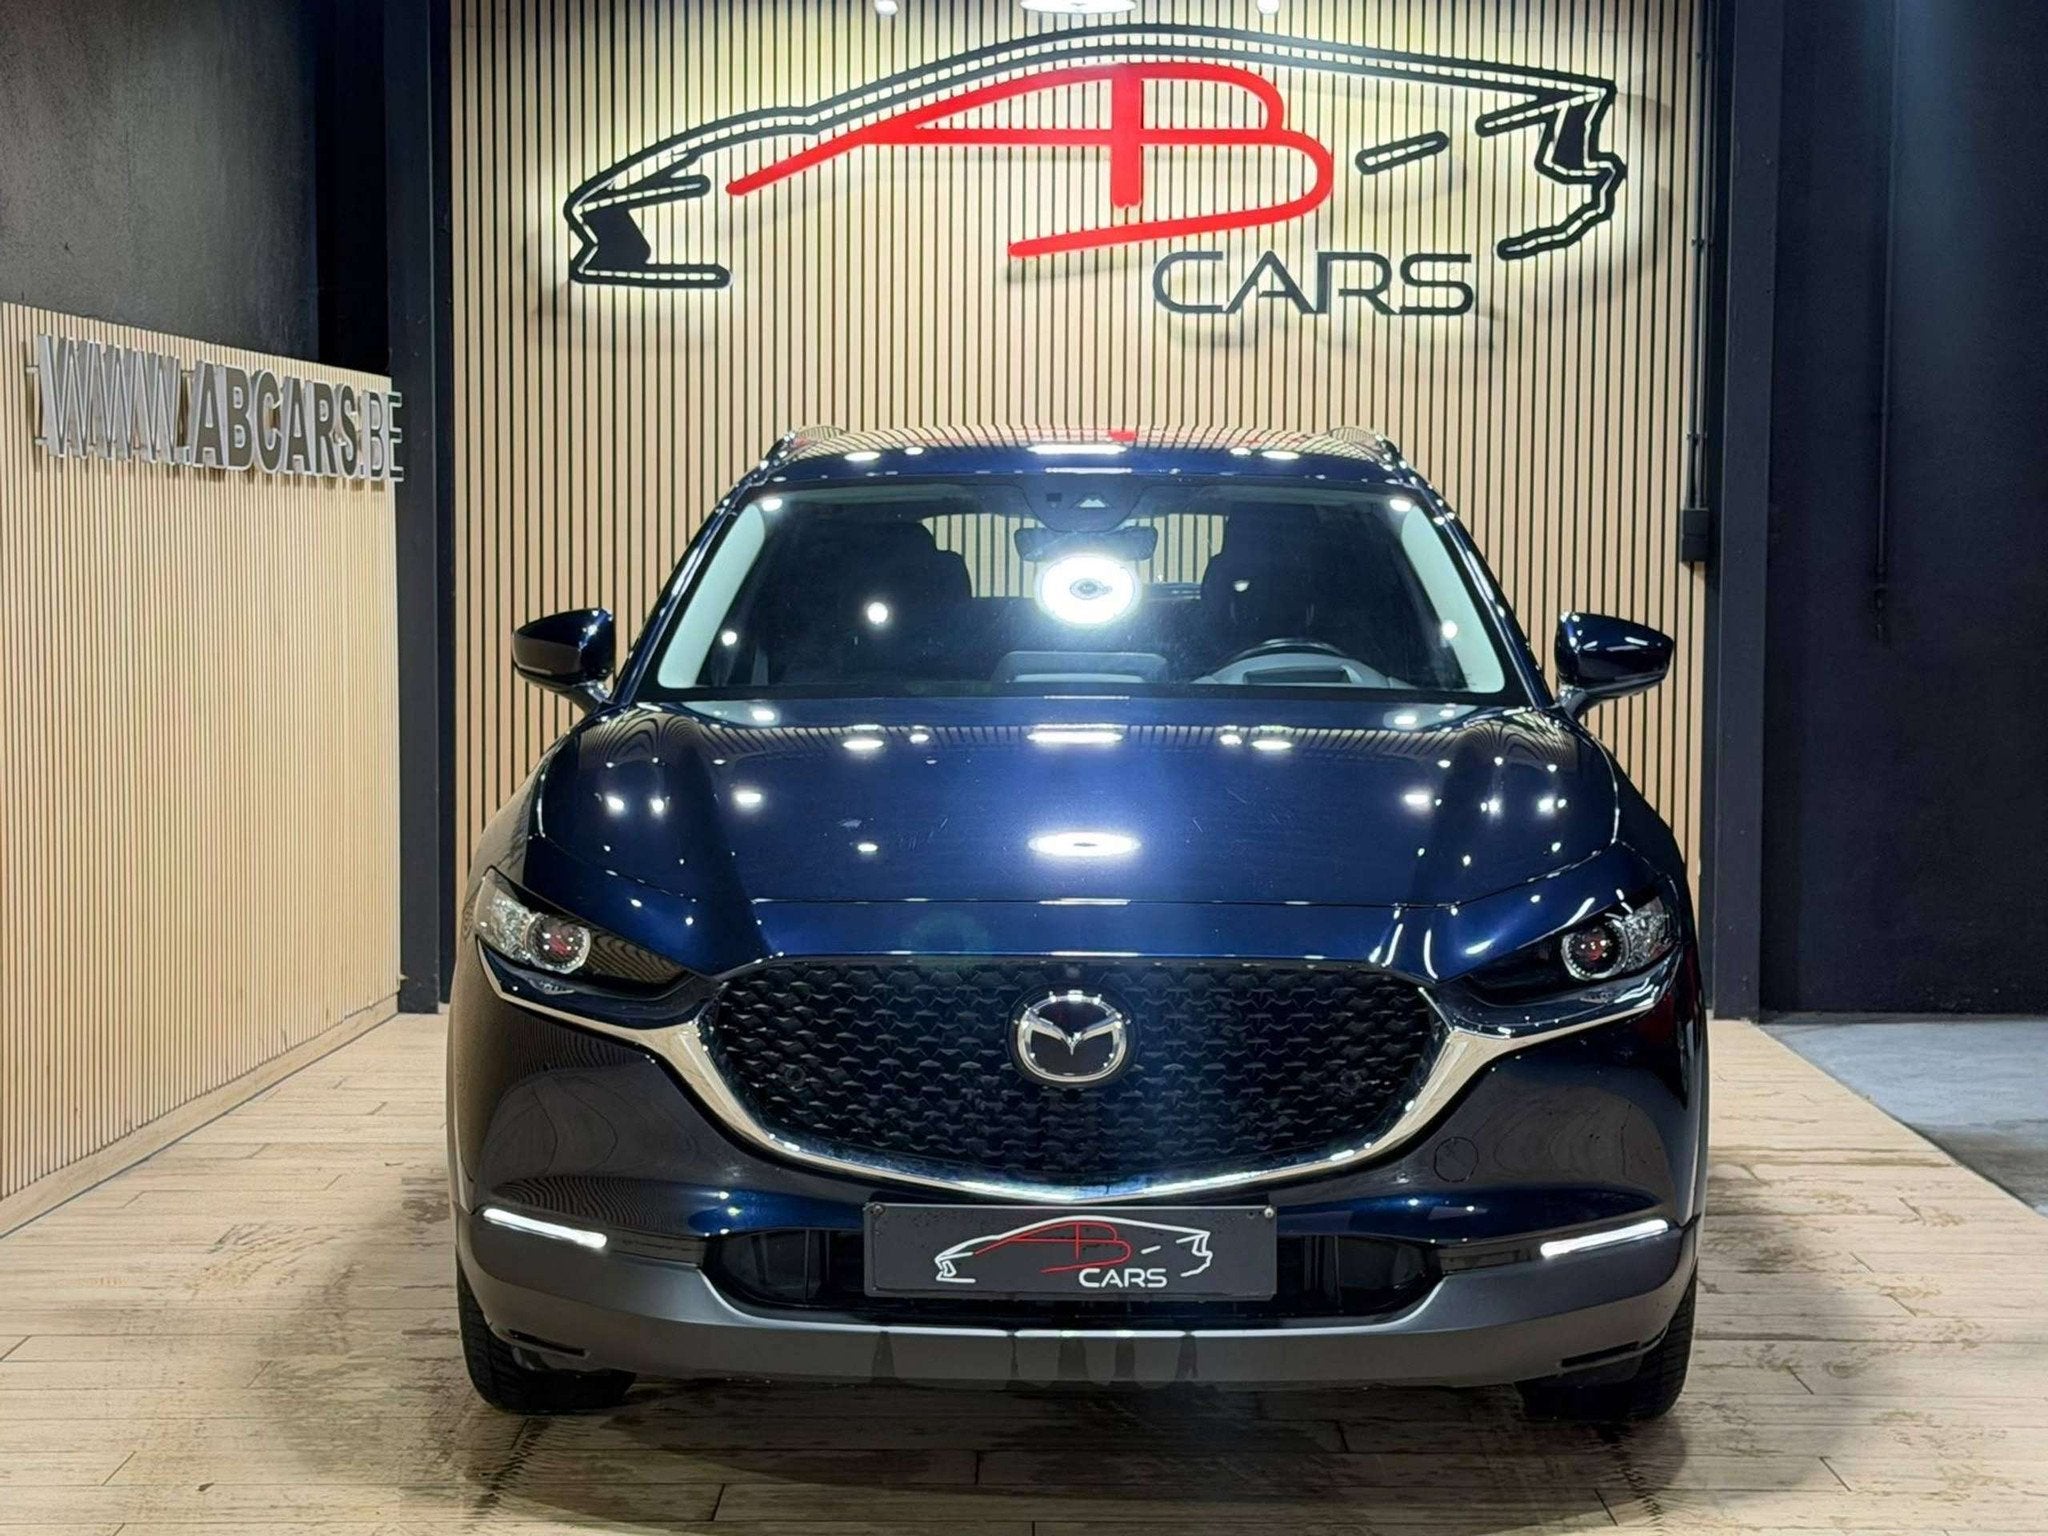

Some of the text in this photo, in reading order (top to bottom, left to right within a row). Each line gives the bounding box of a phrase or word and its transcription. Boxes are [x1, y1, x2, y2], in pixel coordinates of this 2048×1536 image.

[1153, 250, 1474, 315] CARS
[38, 334, 404, 482] WWW.ABCARS.BE
[1079, 1268, 1167, 1288] CARS
